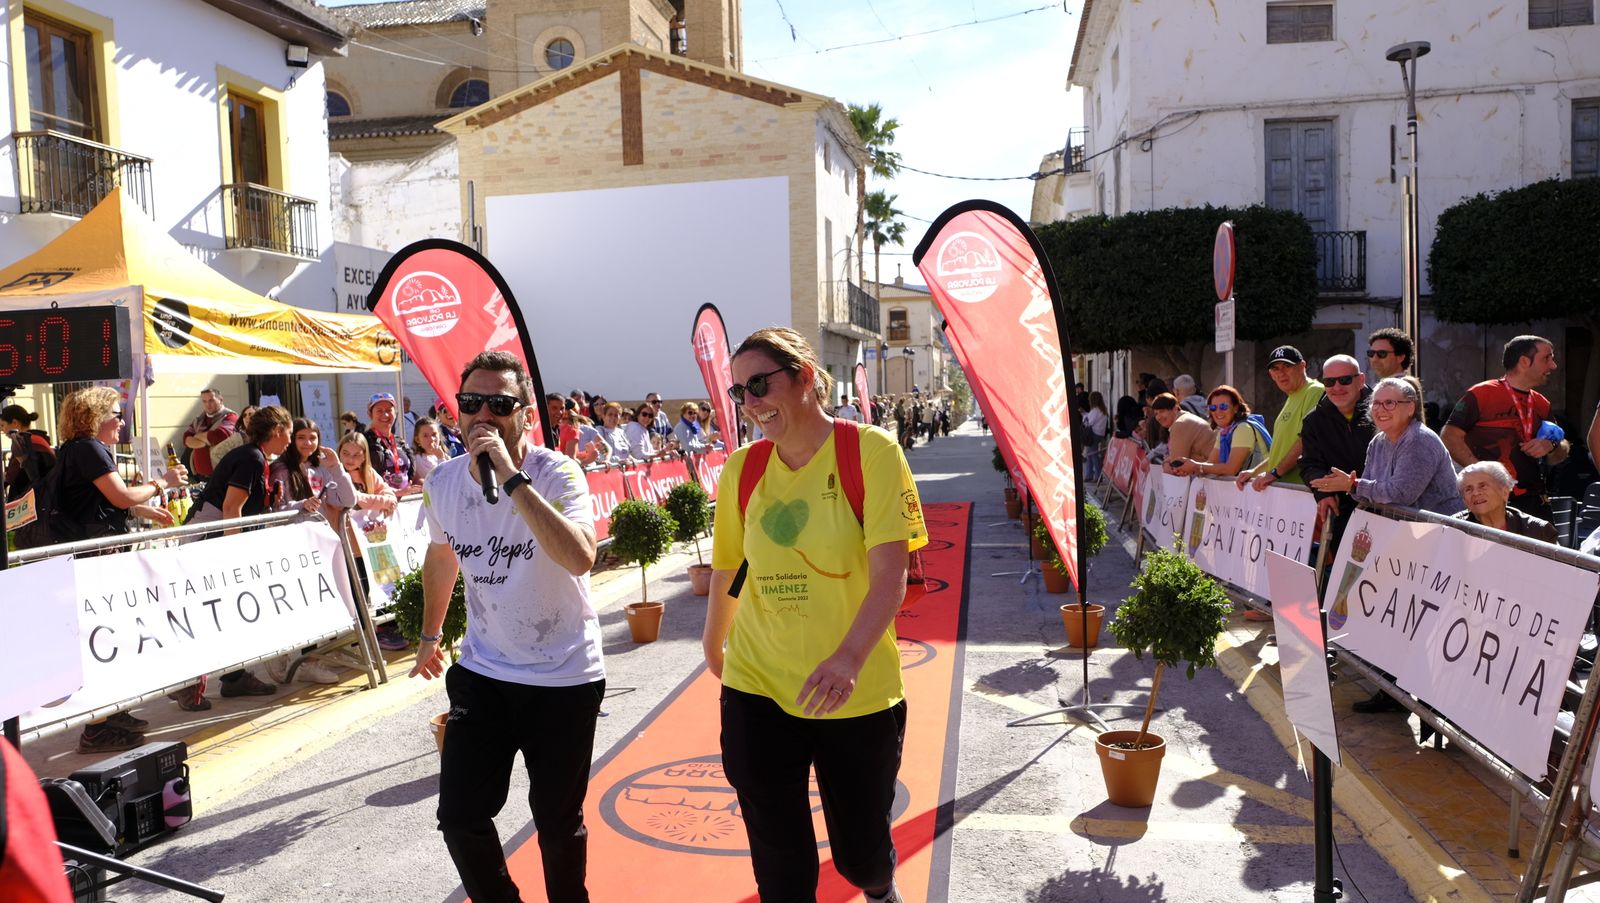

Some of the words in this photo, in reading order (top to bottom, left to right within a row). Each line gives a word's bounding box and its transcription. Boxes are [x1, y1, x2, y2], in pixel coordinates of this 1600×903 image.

[1290, 521, 1305, 539] DE
[84, 557, 291, 616] AYUNTAMIENTO
[298, 550, 322, 569] DE
[470, 570, 509, 586] peaker
[761, 582, 808, 595] JIMÉNEZ
[775, 573, 807, 581] Solidaria
[89, 572, 336, 663] CANTORIA
[1529, 612, 1560, 647] DE
[1358, 579, 1546, 717] CANTORIA
